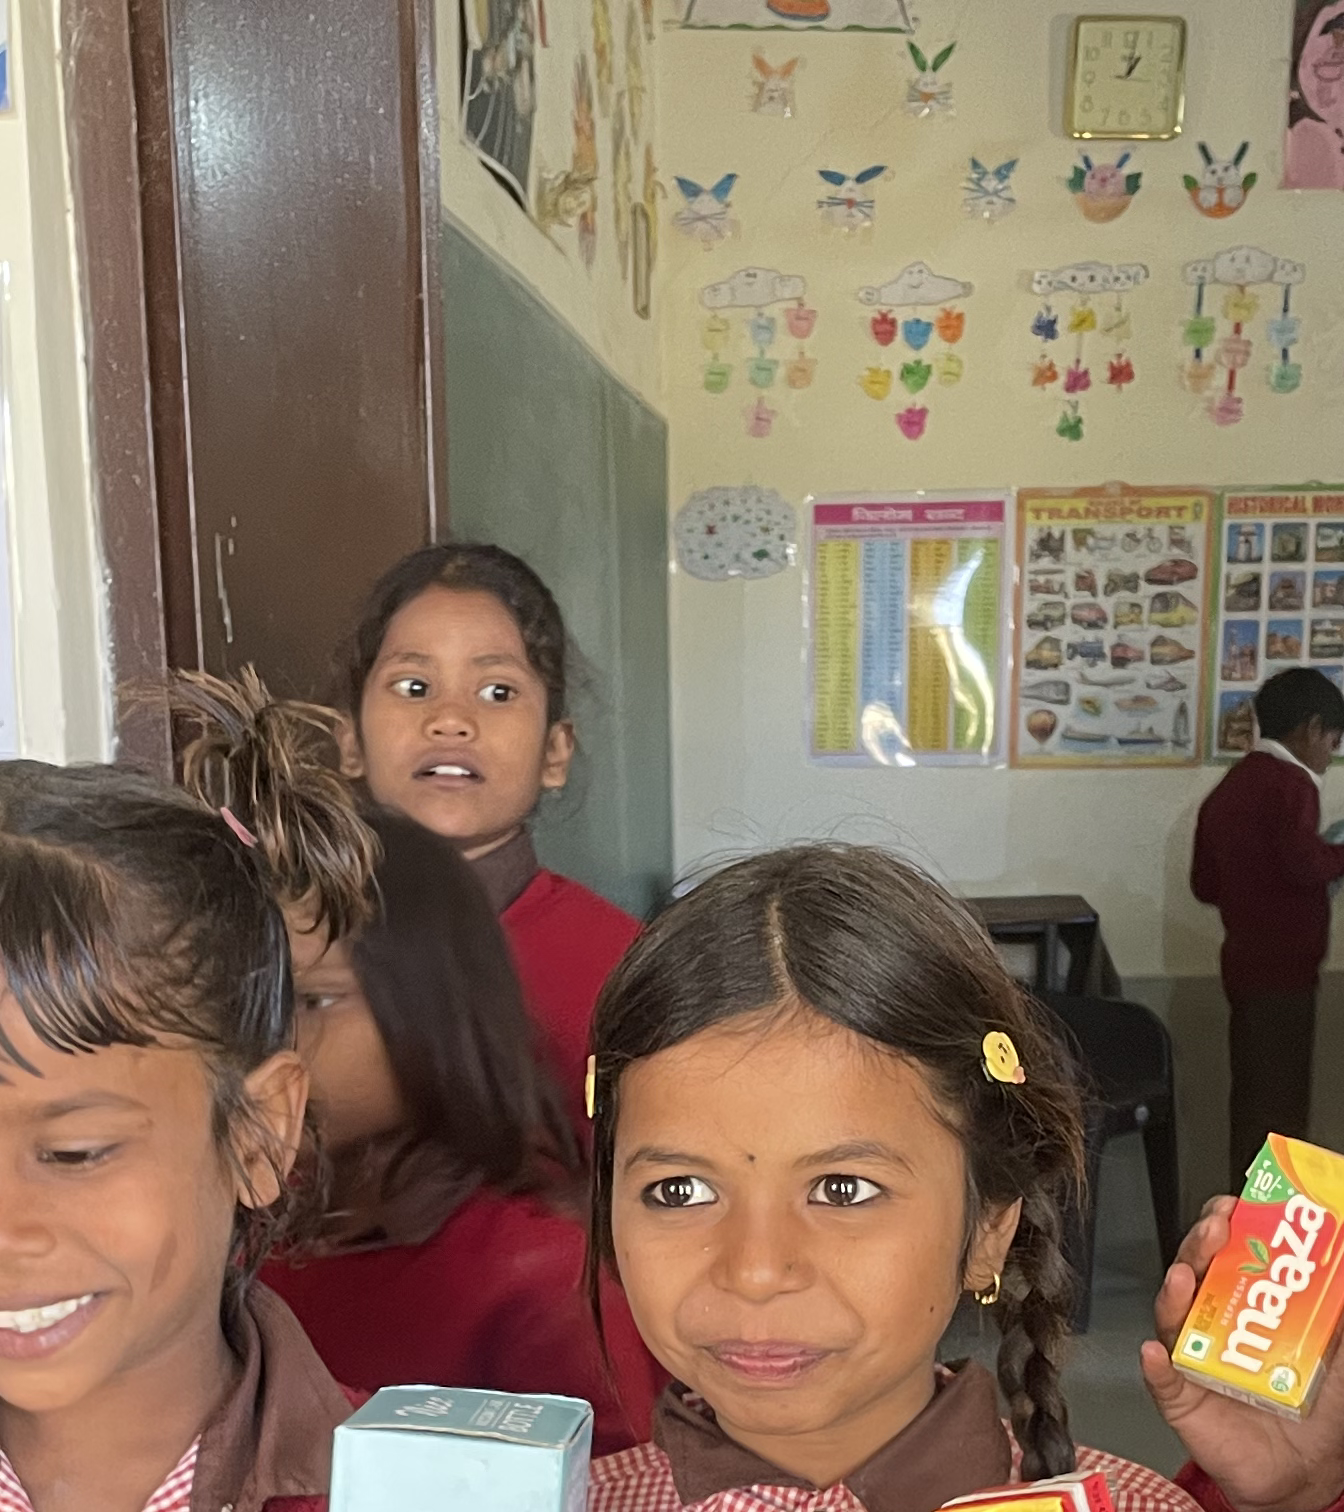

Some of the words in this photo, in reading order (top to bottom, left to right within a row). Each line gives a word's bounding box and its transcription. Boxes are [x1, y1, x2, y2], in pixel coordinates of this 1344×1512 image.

[1030, 504, 1188, 520] TRANSPORT
[1220, 1194, 1328, 1373] maaza
[1220, 1276, 1248, 1327] REFRESH
